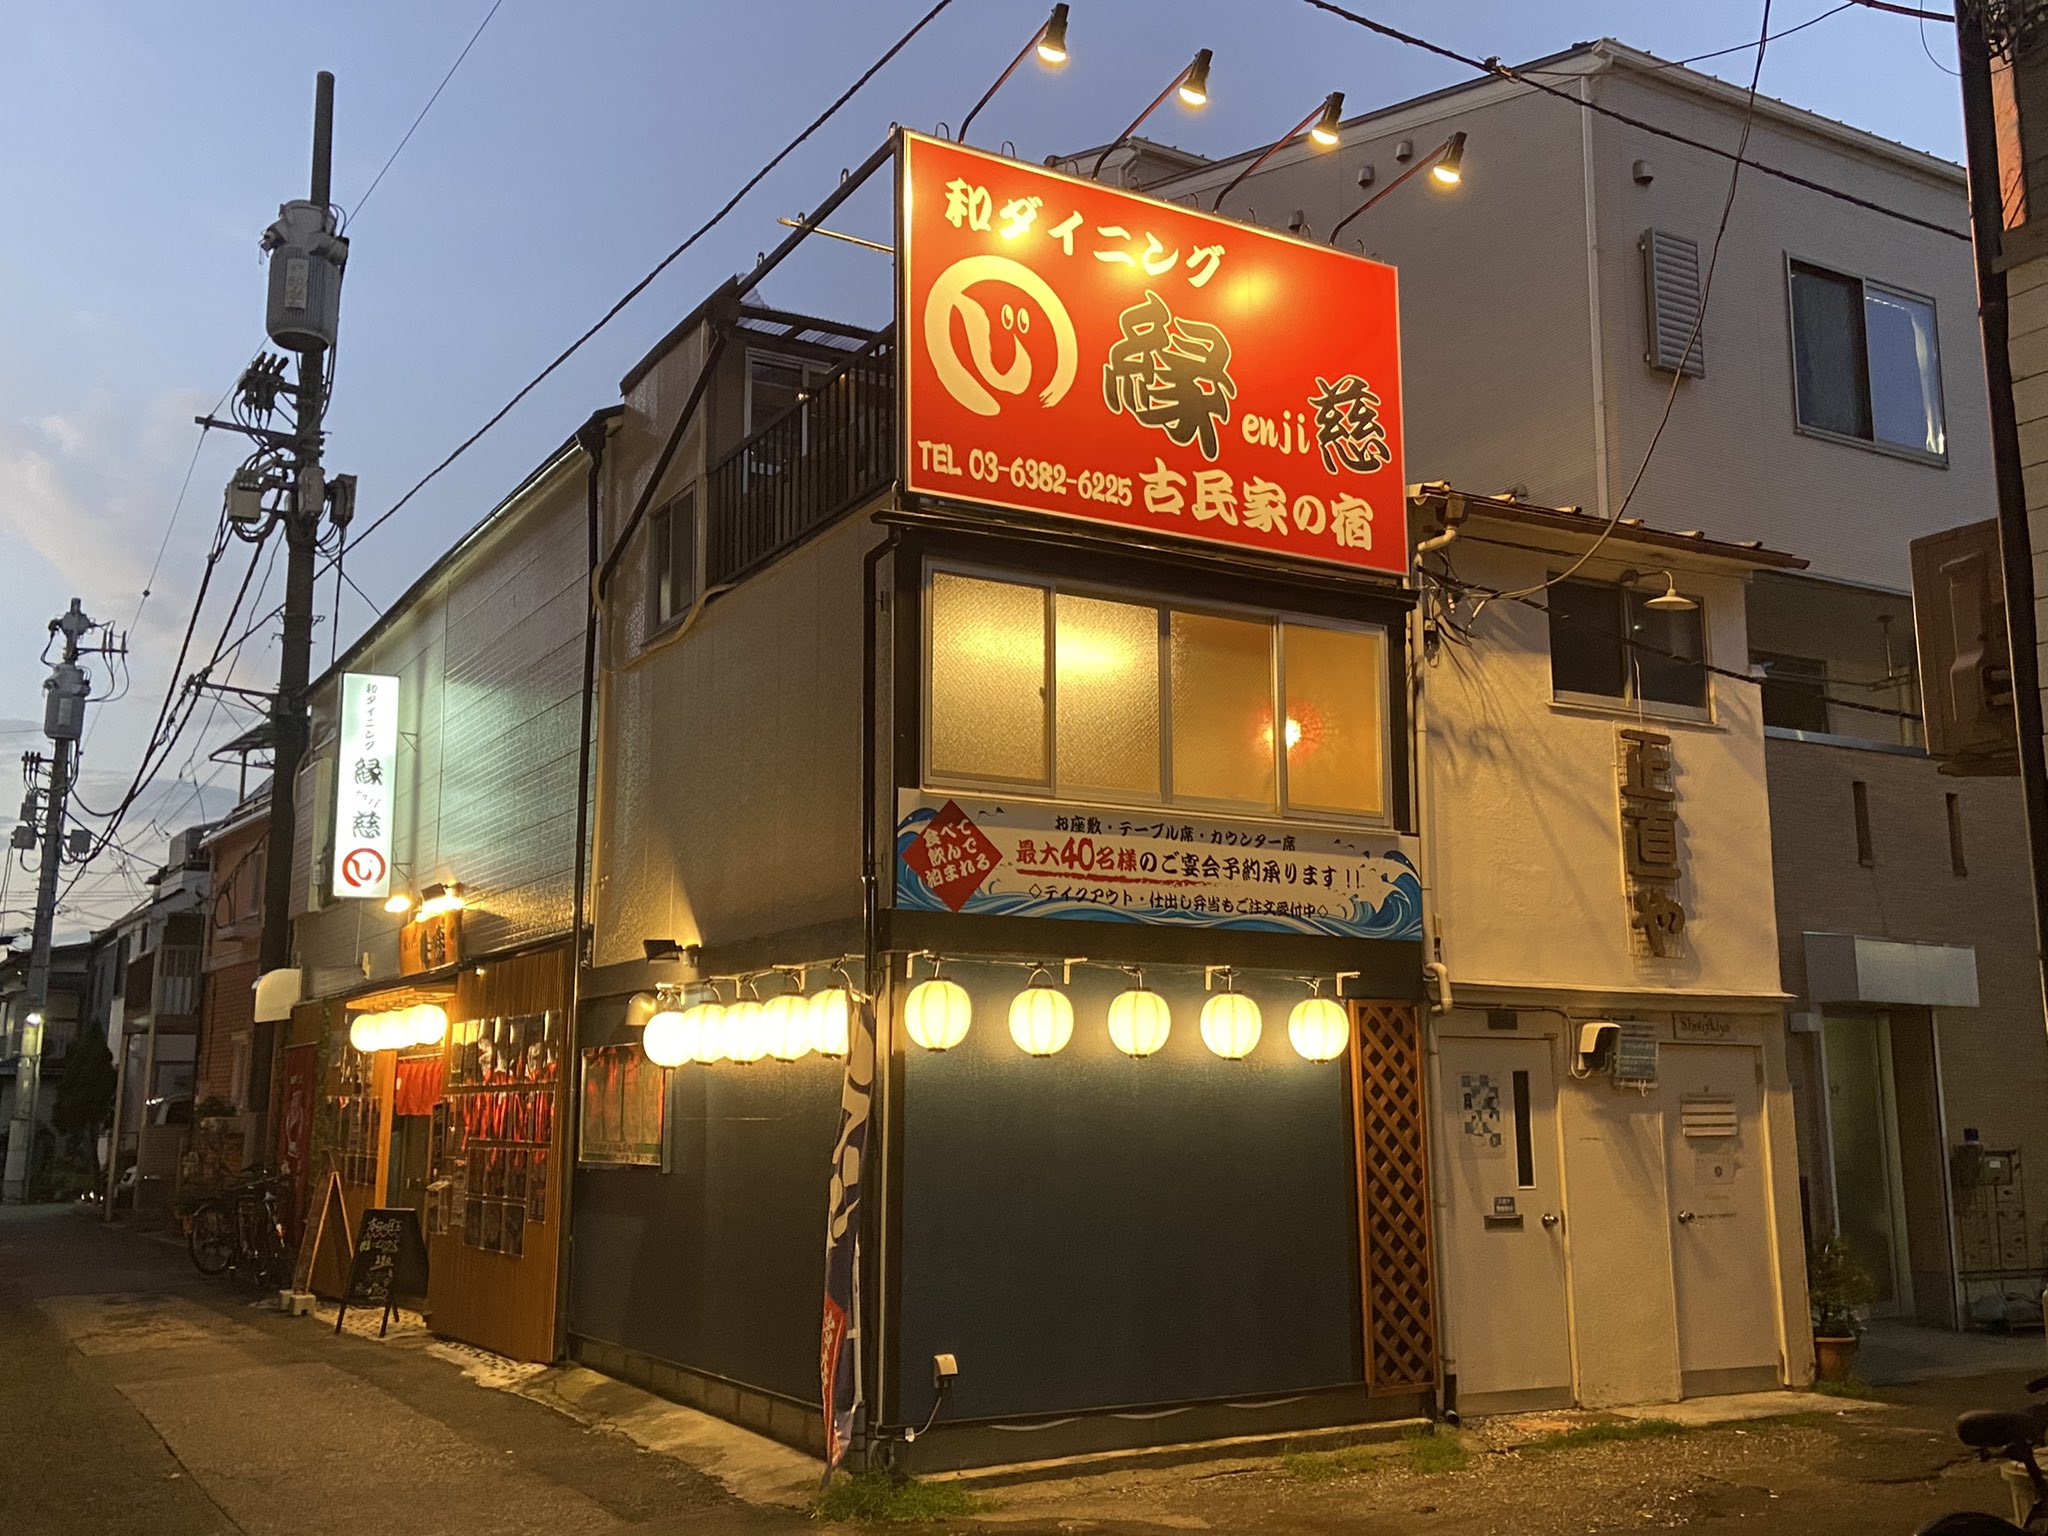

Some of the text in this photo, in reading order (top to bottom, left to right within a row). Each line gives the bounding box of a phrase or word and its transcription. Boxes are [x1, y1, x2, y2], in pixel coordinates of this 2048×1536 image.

[944, 177, 1226, 287] 和ダイニング
[1102, 289, 1391, 475] 縁 enji 慈
[917, 439, 1133, 506] TEL 03-6382-6225
[1139, 457, 1374, 551] 古民家の宿
[922, 817, 973, 848] 食べて
[927, 837, 978, 867] 飲んで
[924, 854, 991, 889] 泊まれる
